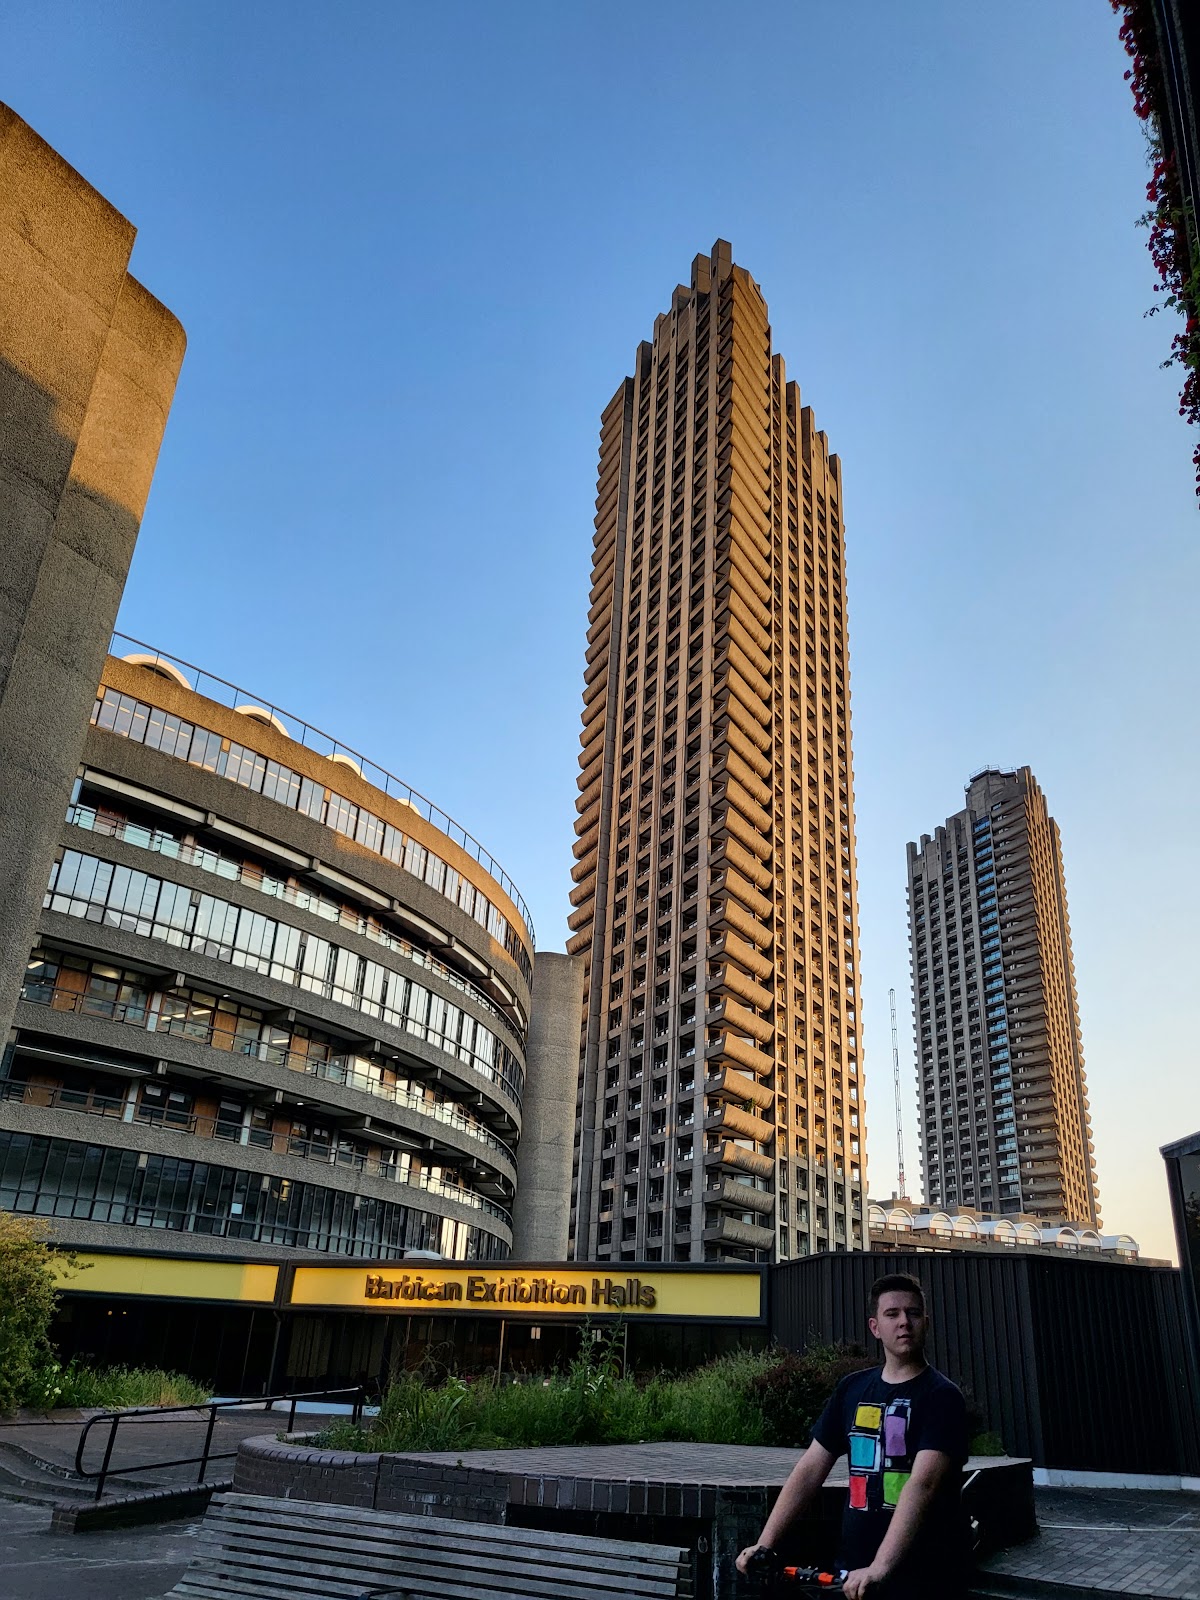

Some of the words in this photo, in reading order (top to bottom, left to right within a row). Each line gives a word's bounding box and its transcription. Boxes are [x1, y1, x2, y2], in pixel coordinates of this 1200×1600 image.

[365, 1274, 462, 1300] Barbican
[466, 1276, 586, 1304] Exhibition
[592, 1278, 656, 1308] Halls
